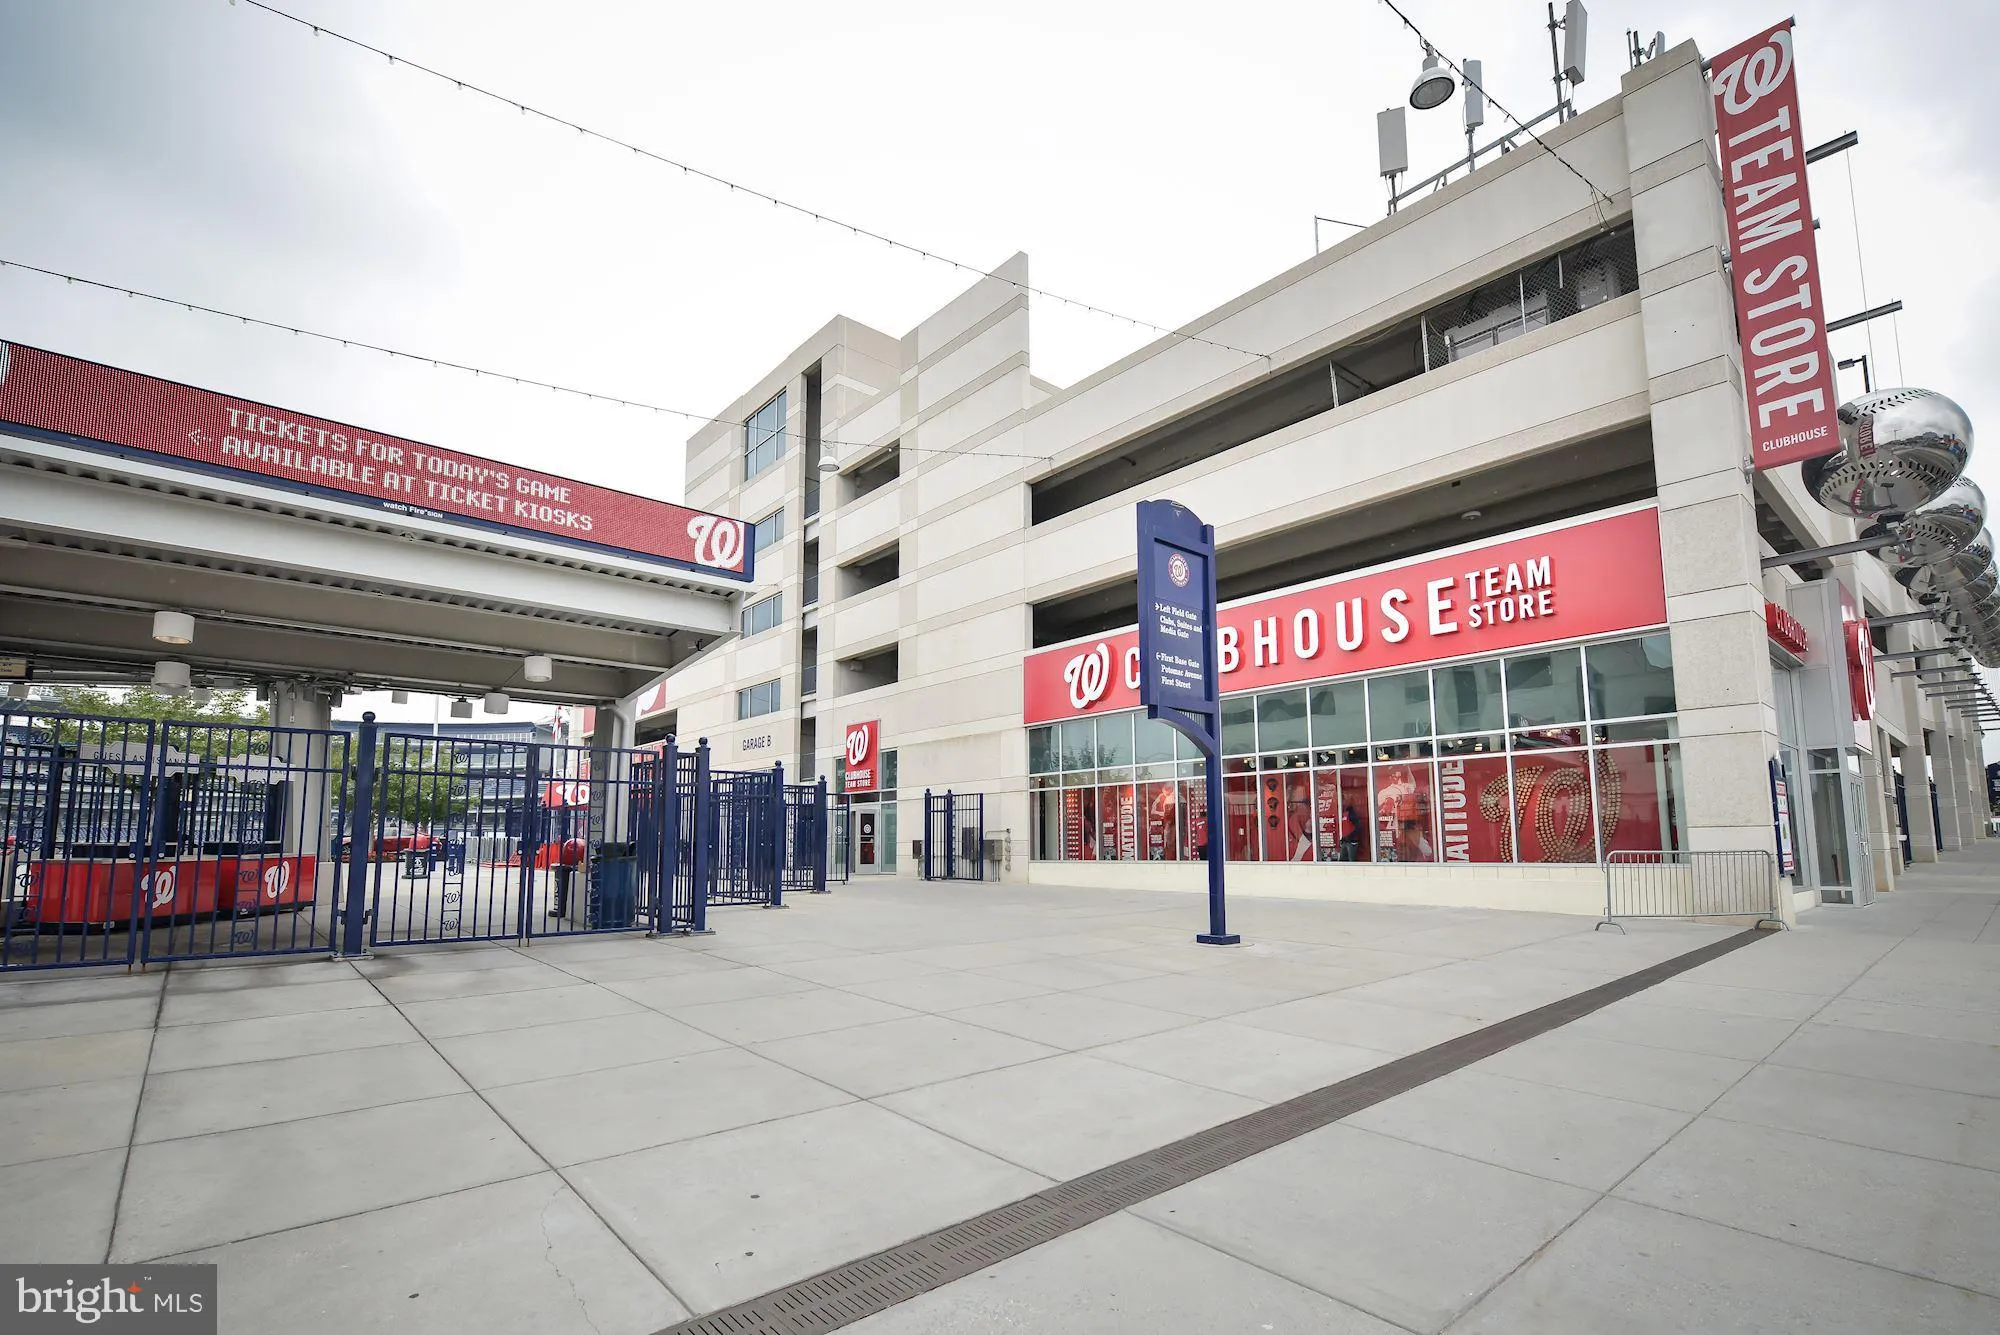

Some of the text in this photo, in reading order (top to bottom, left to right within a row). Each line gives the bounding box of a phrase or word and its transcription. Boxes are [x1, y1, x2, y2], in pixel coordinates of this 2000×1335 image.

[1727, 104, 1825, 429] TEAM STORE
[1762, 426, 1829, 452] CLUBHOUSE
[226, 407, 348, 452] TICKETS
[356, 438, 404, 466] FOR
[515, 477, 572, 504] GAME
[222, 435, 593, 532] AVAILABLE AT TICKET KIOSKS
[383, 502, 407, 512] watch
[427, 510, 443, 519] SIGN
[1464, 555, 1551, 600] TEAM
[1160, 603, 1198, 621] Left Field Gate
[1467, 590, 1554, 628] STORE
[1124, 576, 1459, 690] CBHOUSE
[1160, 625, 1189, 639] Media Gate
[1176, 619, 1193, 631] Suites
[1193, 625, 1203, 633] and
[1160, 652, 1200, 669] First Base Gate
[1161, 664, 1202, 680] Potomac Avenue
[1161, 676, 1191, 689] First Street
[743, 734, 772, 751] GARAGE B
[845, 769, 871, 780] CLUBHOUSE
[845, 779, 871, 788] TEAM STORE
